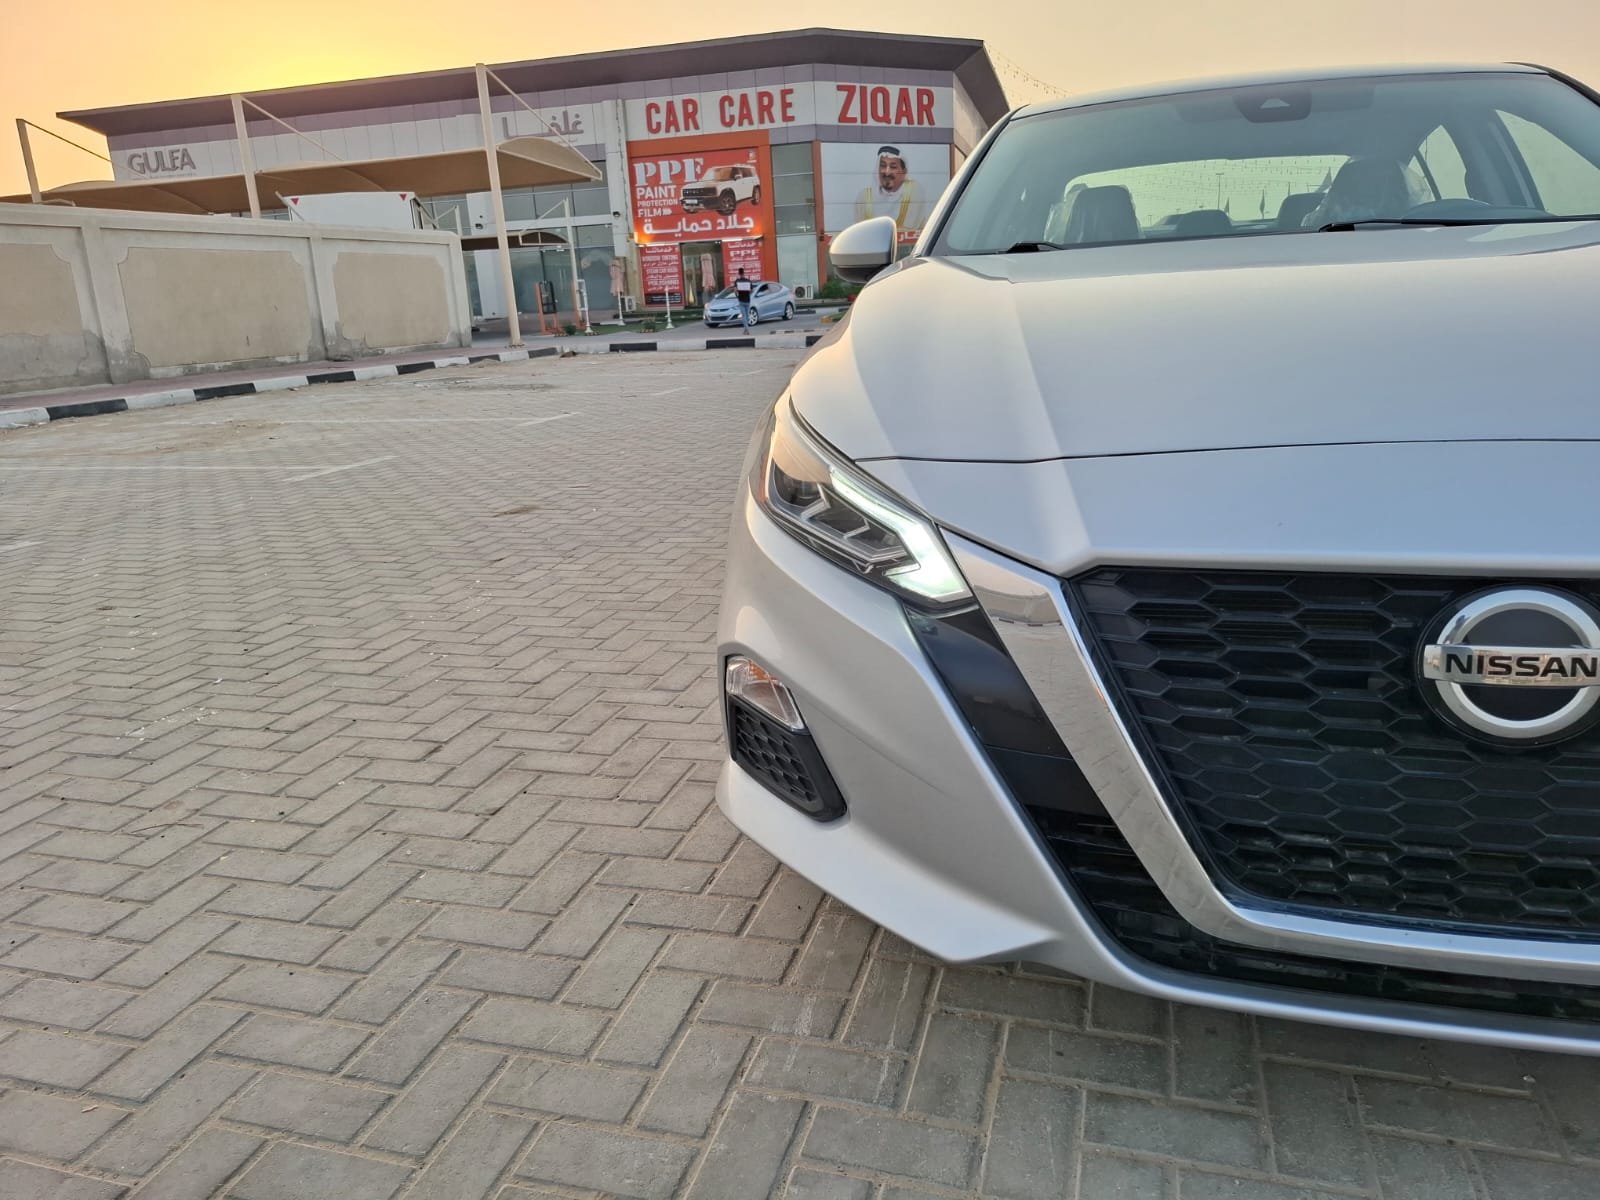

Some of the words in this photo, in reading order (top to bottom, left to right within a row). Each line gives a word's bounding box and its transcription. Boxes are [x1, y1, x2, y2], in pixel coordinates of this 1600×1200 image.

[645, 98, 699, 134] CAR
[719, 88, 795, 128] CARE
[836, 84, 935, 126] ZIQAR
[127, 148, 197, 175] GULFA
[633, 157, 704, 187] PPF
[636, 184, 677, 199] PAINT
[637, 197, 678, 208] PROTECTION
[638, 207, 662, 218] FILM
[716, 212, 754, 233] جلاد
[643, 216, 712, 238] حماية
[1445, 653, 1598, 678] NISSAN
